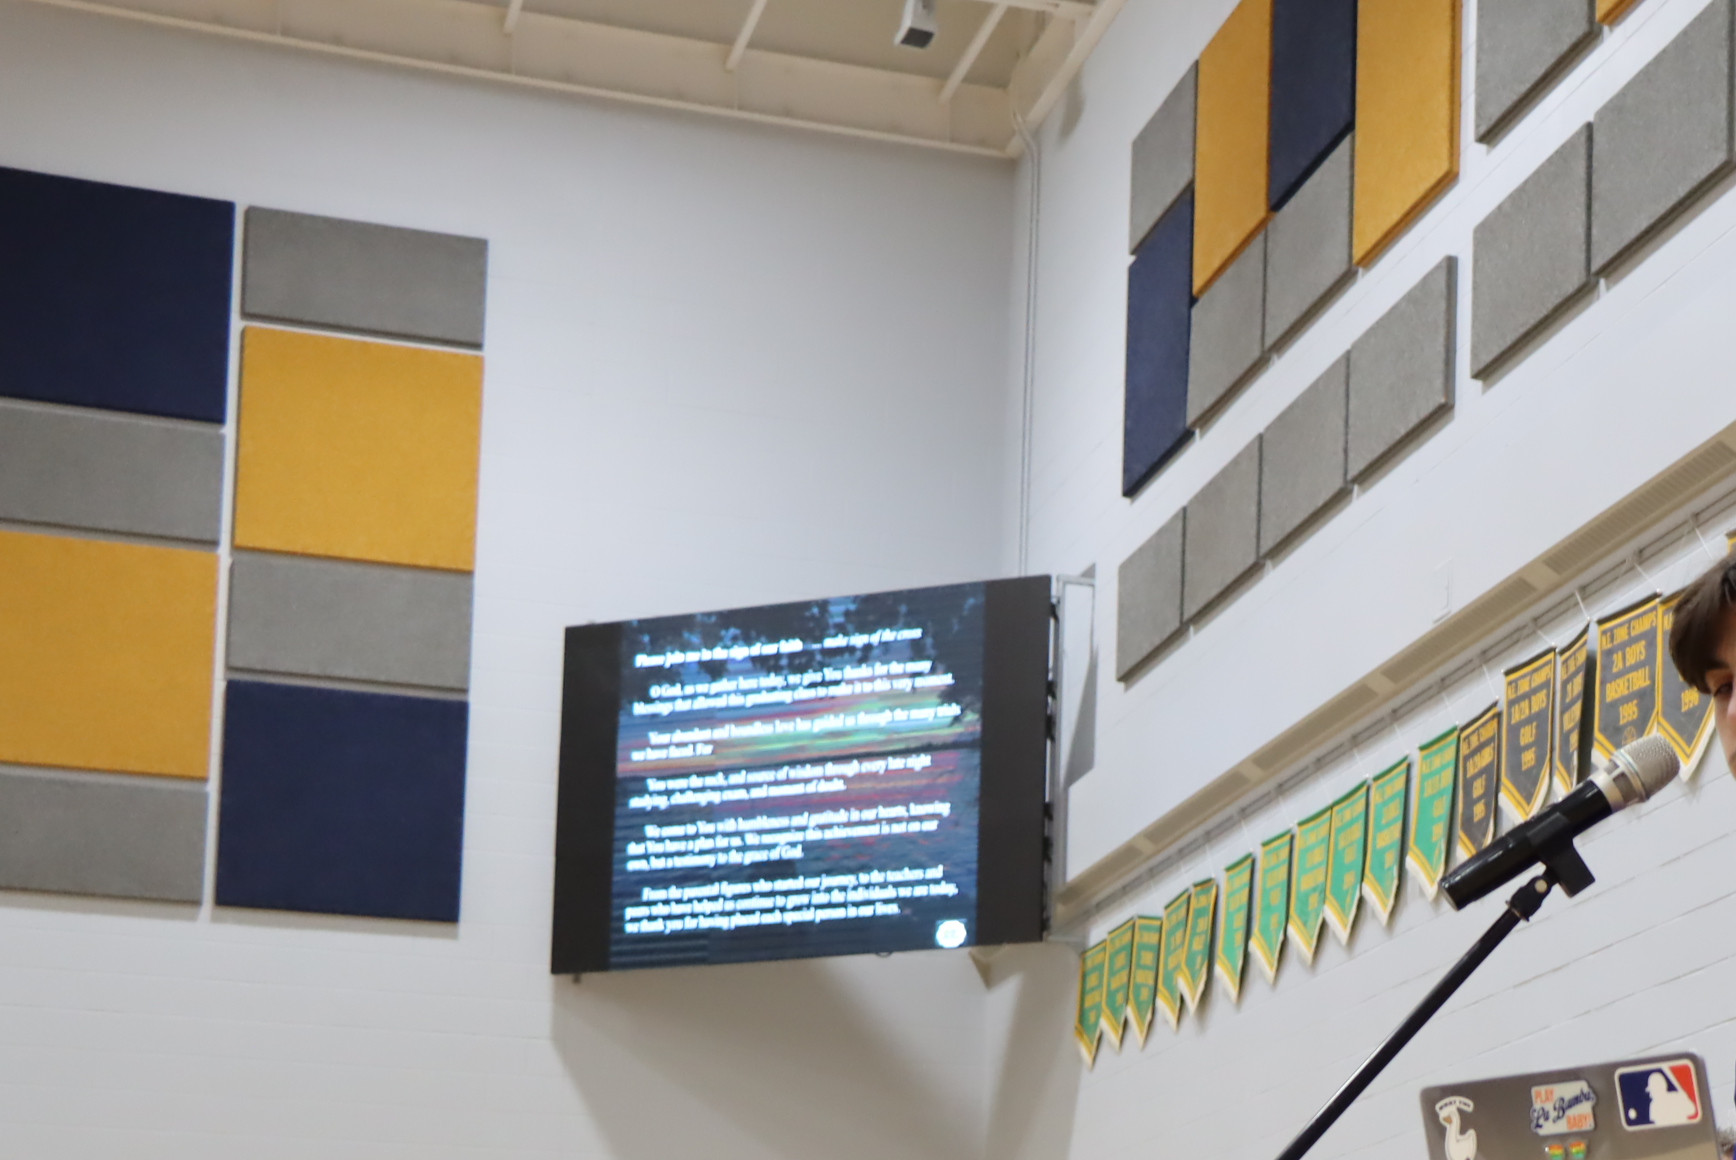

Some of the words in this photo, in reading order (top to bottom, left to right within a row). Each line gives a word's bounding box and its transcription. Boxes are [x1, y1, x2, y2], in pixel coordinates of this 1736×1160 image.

[1613, 623, 1629, 645] ZONE
[1630, 611, 1657, 636] CHAMPS
[1612, 651, 1623, 673] 2A
[1625, 640, 1646, 667] BOYS
[1605, 665, 1650, 703] BASKETBALL
[1519, 721, 1537, 747] GOLF
